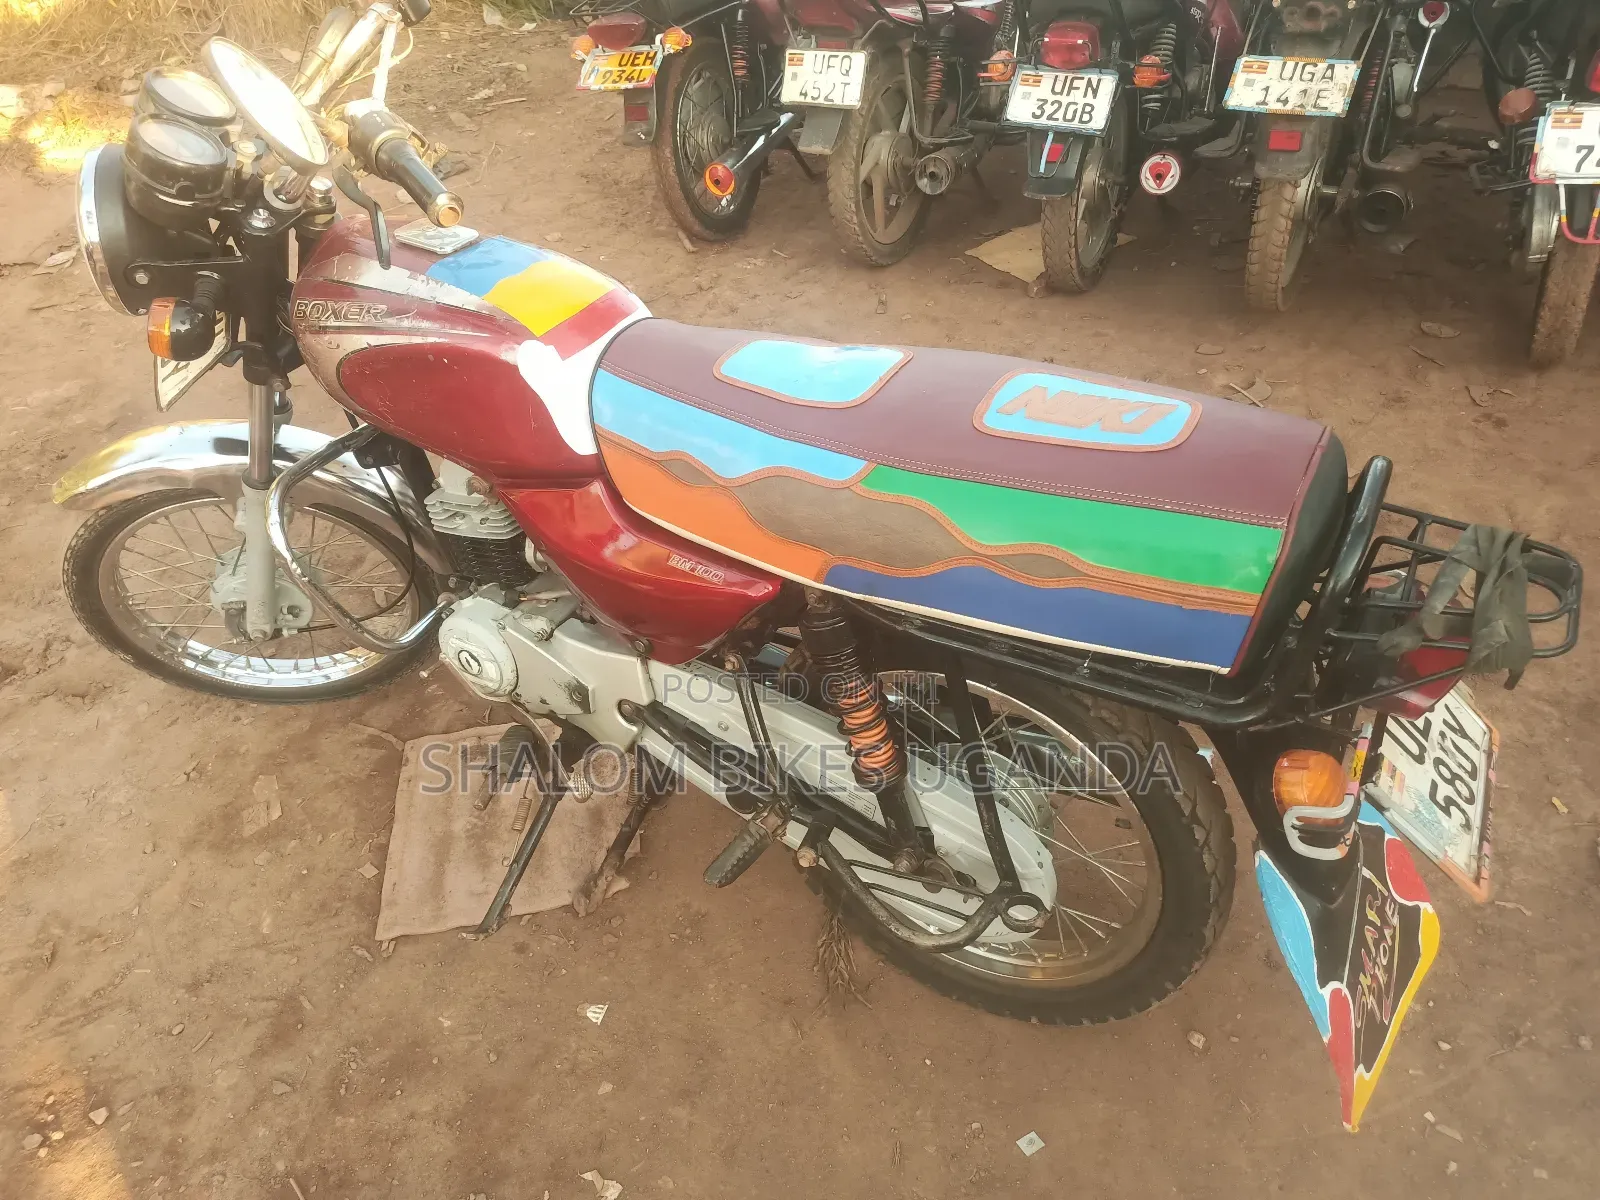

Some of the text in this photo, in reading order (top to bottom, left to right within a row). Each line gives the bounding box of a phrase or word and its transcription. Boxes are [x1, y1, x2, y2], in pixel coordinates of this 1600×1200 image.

[617, 52, 657, 68] UEH
[813, 54, 852, 77] UFQ
[1280, 61, 1336, 82] UGA
[799, 80, 850, 103] 452T
[1051, 75, 1101, 99] UFN
[1032, 99, 1095, 124] 320B
[1575, 144, 1600, 173] 7
[293, 299, 388, 323] BOXER
